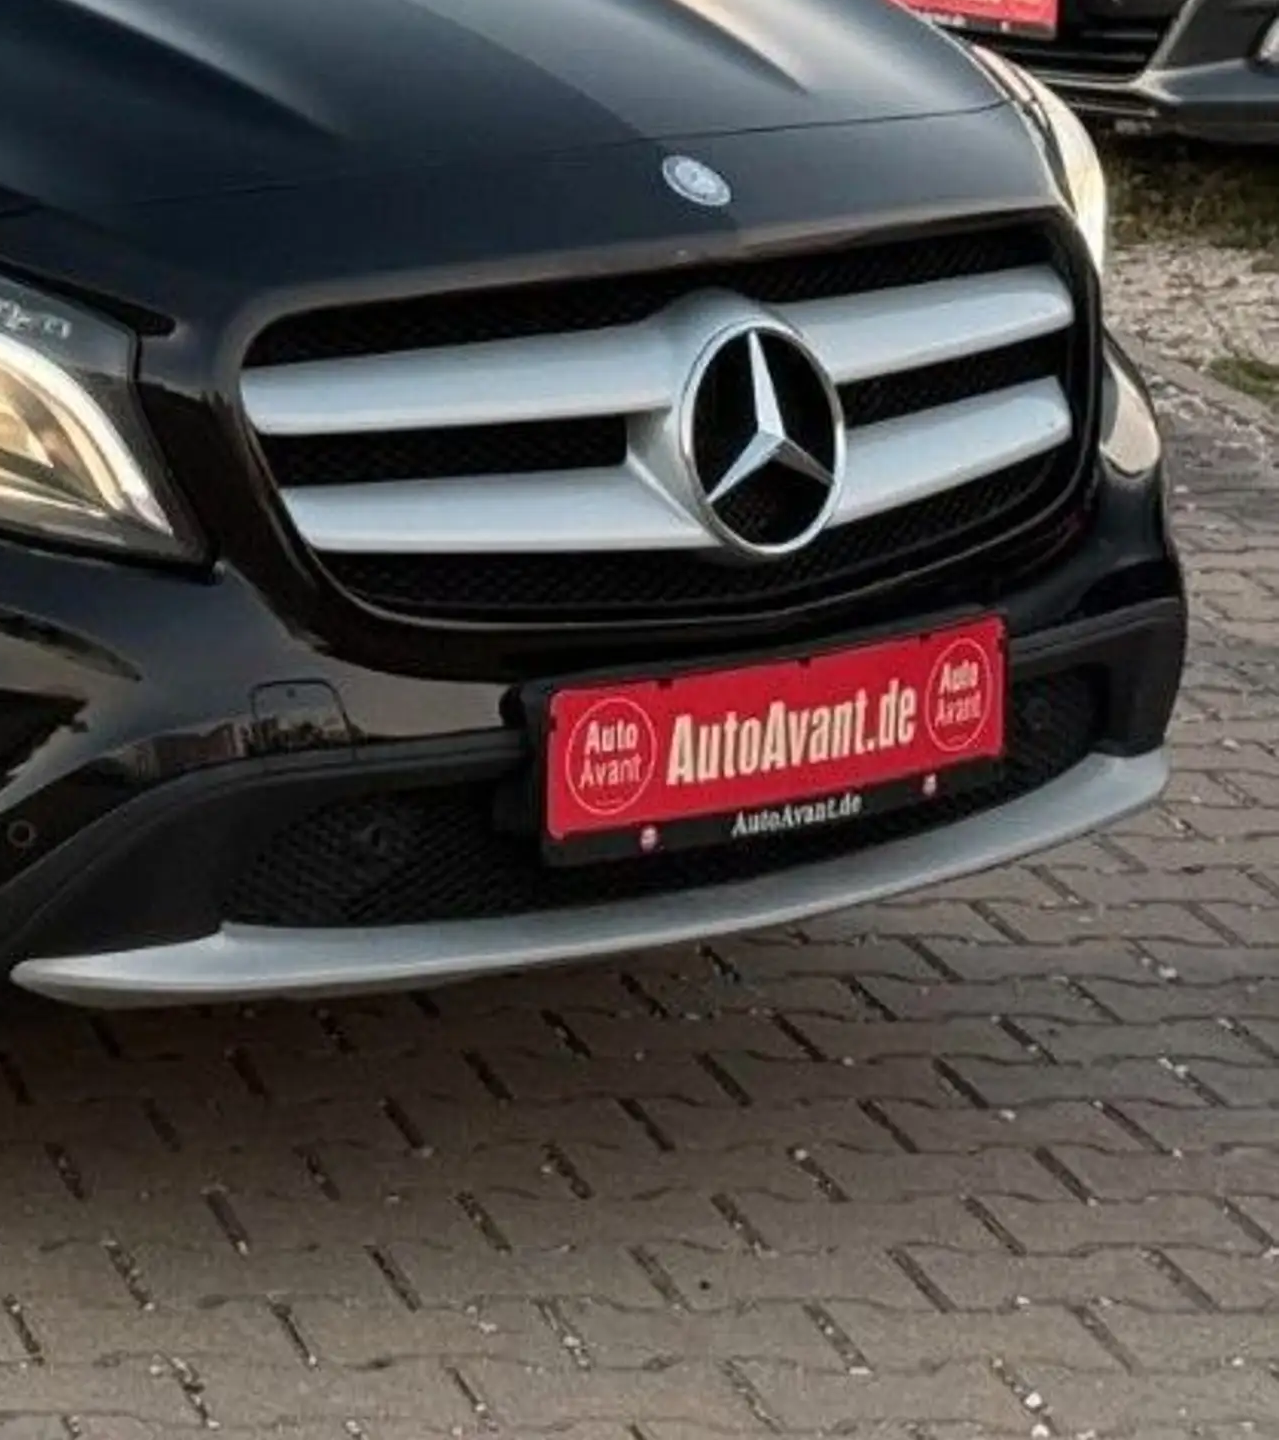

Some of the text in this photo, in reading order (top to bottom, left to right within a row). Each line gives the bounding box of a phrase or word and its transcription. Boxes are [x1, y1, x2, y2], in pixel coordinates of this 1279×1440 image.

[938, 658, 979, 695] Auto
[584, 719, 639, 755] Auto
[666, 677, 917, 786] AutoAvant.de
[578, 753, 643, 790] Avant
[732, 792, 863, 838] AutoAvant.de
